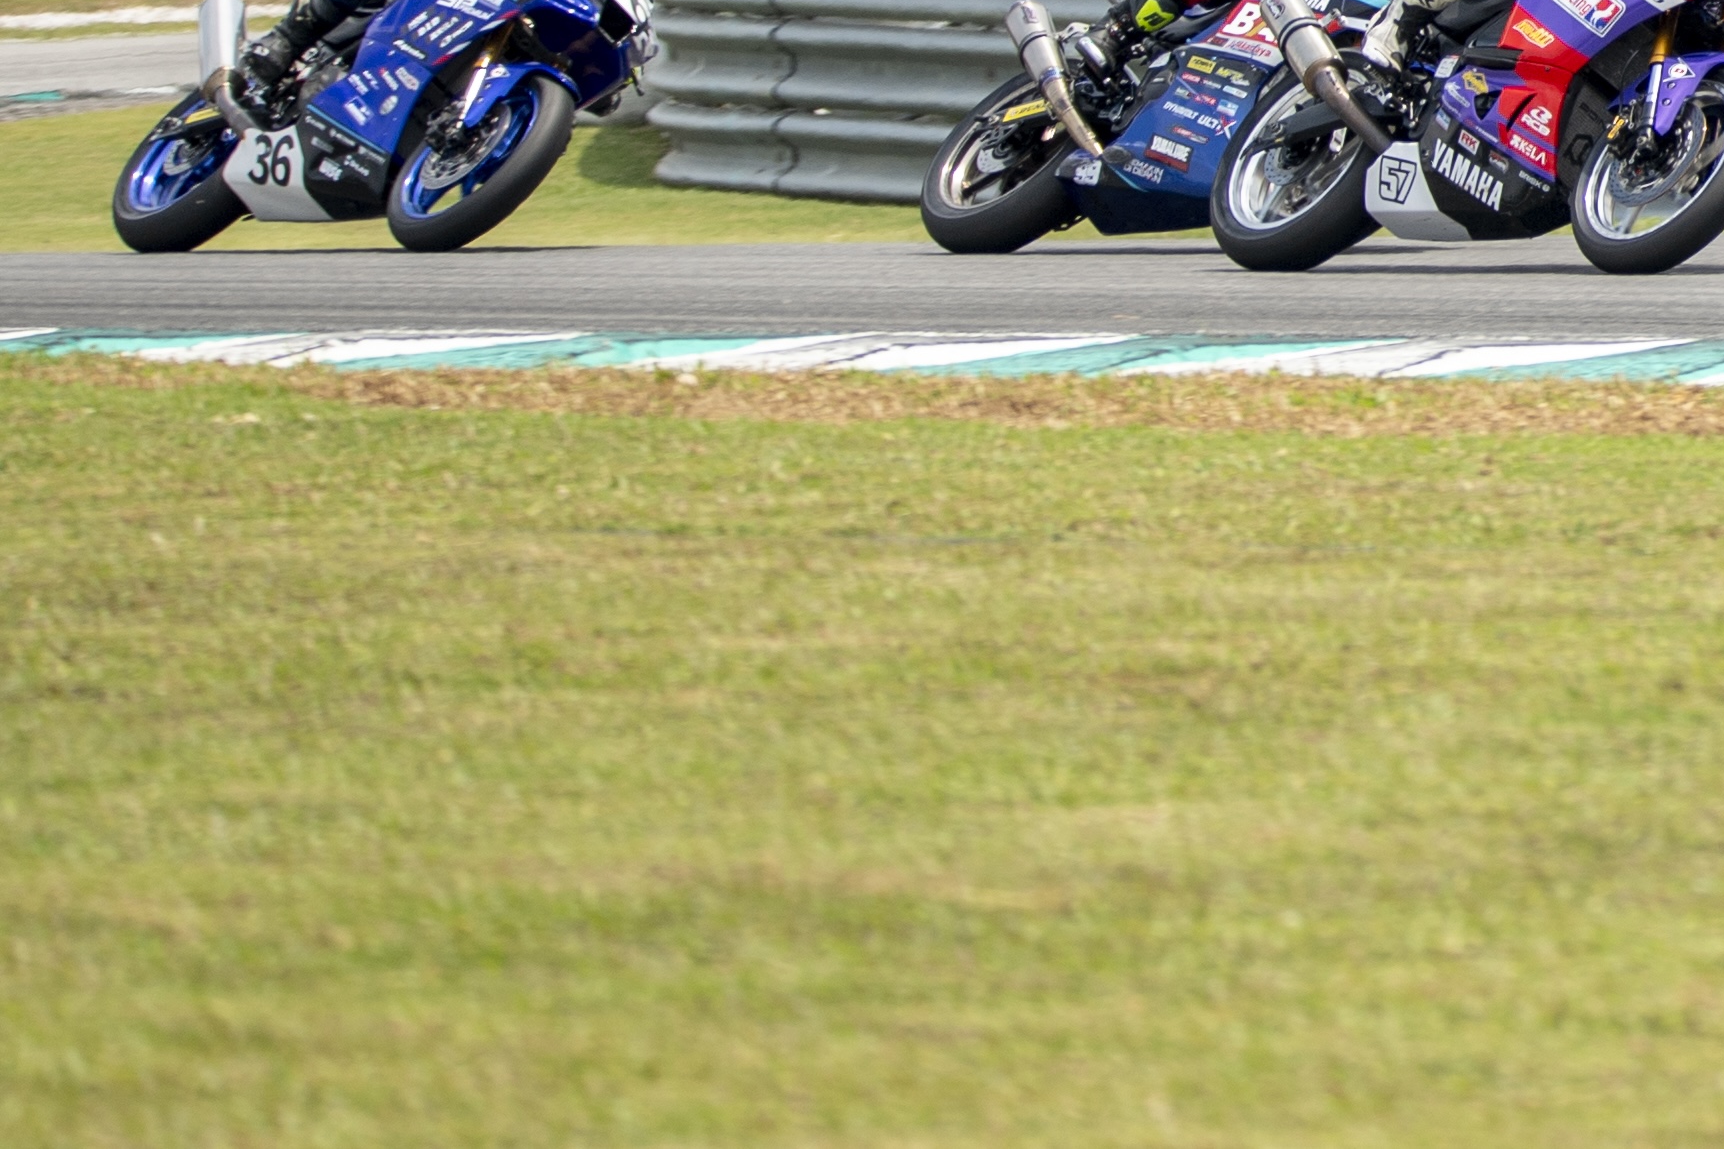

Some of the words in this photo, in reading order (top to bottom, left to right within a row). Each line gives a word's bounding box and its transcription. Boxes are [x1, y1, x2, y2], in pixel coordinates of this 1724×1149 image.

[247, 133, 295, 188] 36
[1379, 155, 1417, 205] 57
[1431, 137, 1505, 212] YAMAHA
